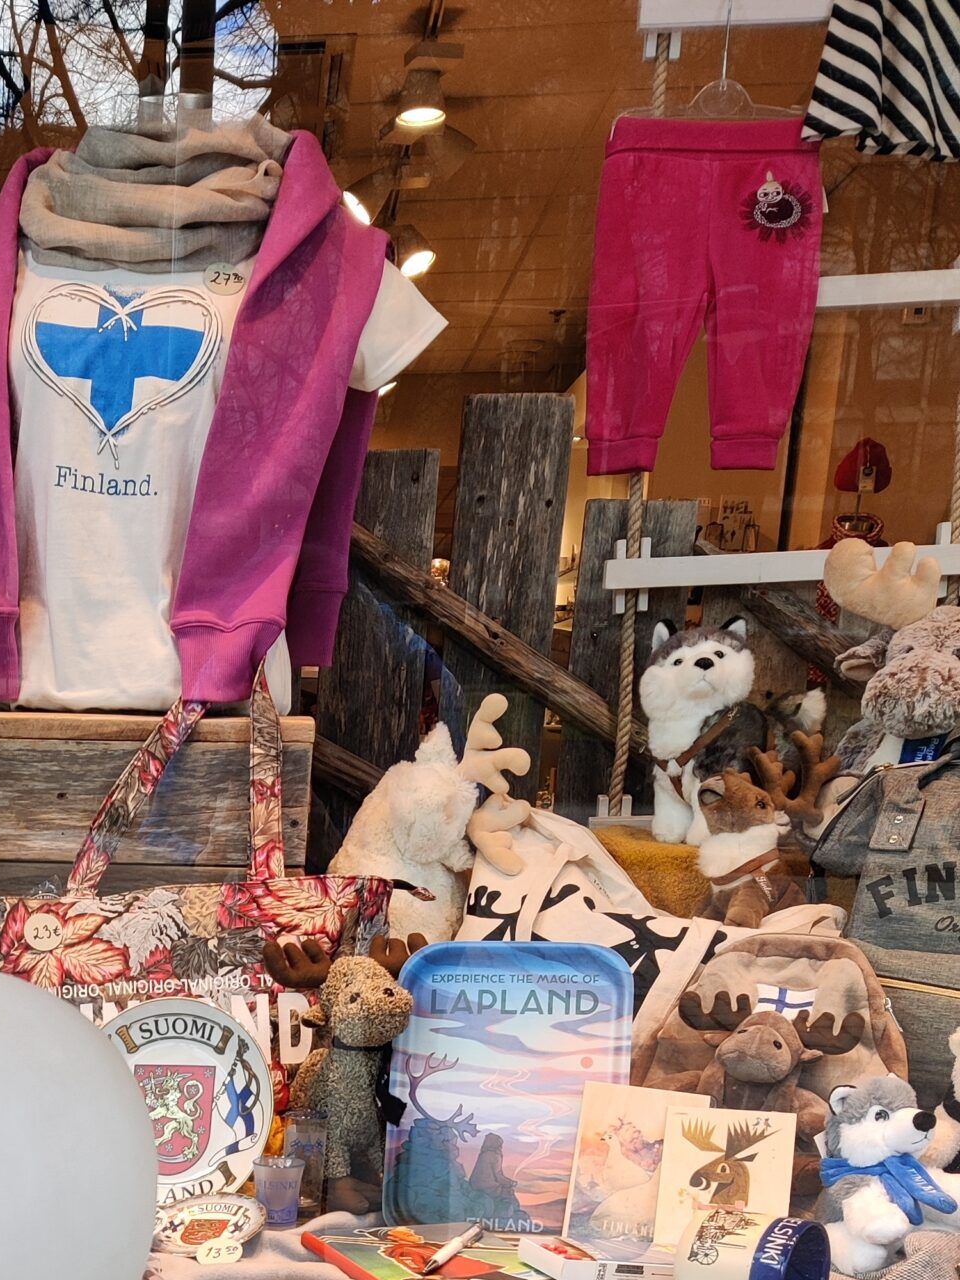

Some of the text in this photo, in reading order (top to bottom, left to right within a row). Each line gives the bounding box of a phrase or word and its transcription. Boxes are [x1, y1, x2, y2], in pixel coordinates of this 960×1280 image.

[53, 465, 158, 497] Finland.
[33, 923, 62, 941] 23€
[105, 978, 176, 995] ORIGINAL
[182, 974, 251, 993] ORIGINAL
[431, 973, 602, 984] EXPERIENCE THE MAGIC OF
[430, 989, 600, 1015] LAPLAND
[139, 1017, 216, 1042] SUOMI
[197, 1203, 235, 1214] SUOMI
